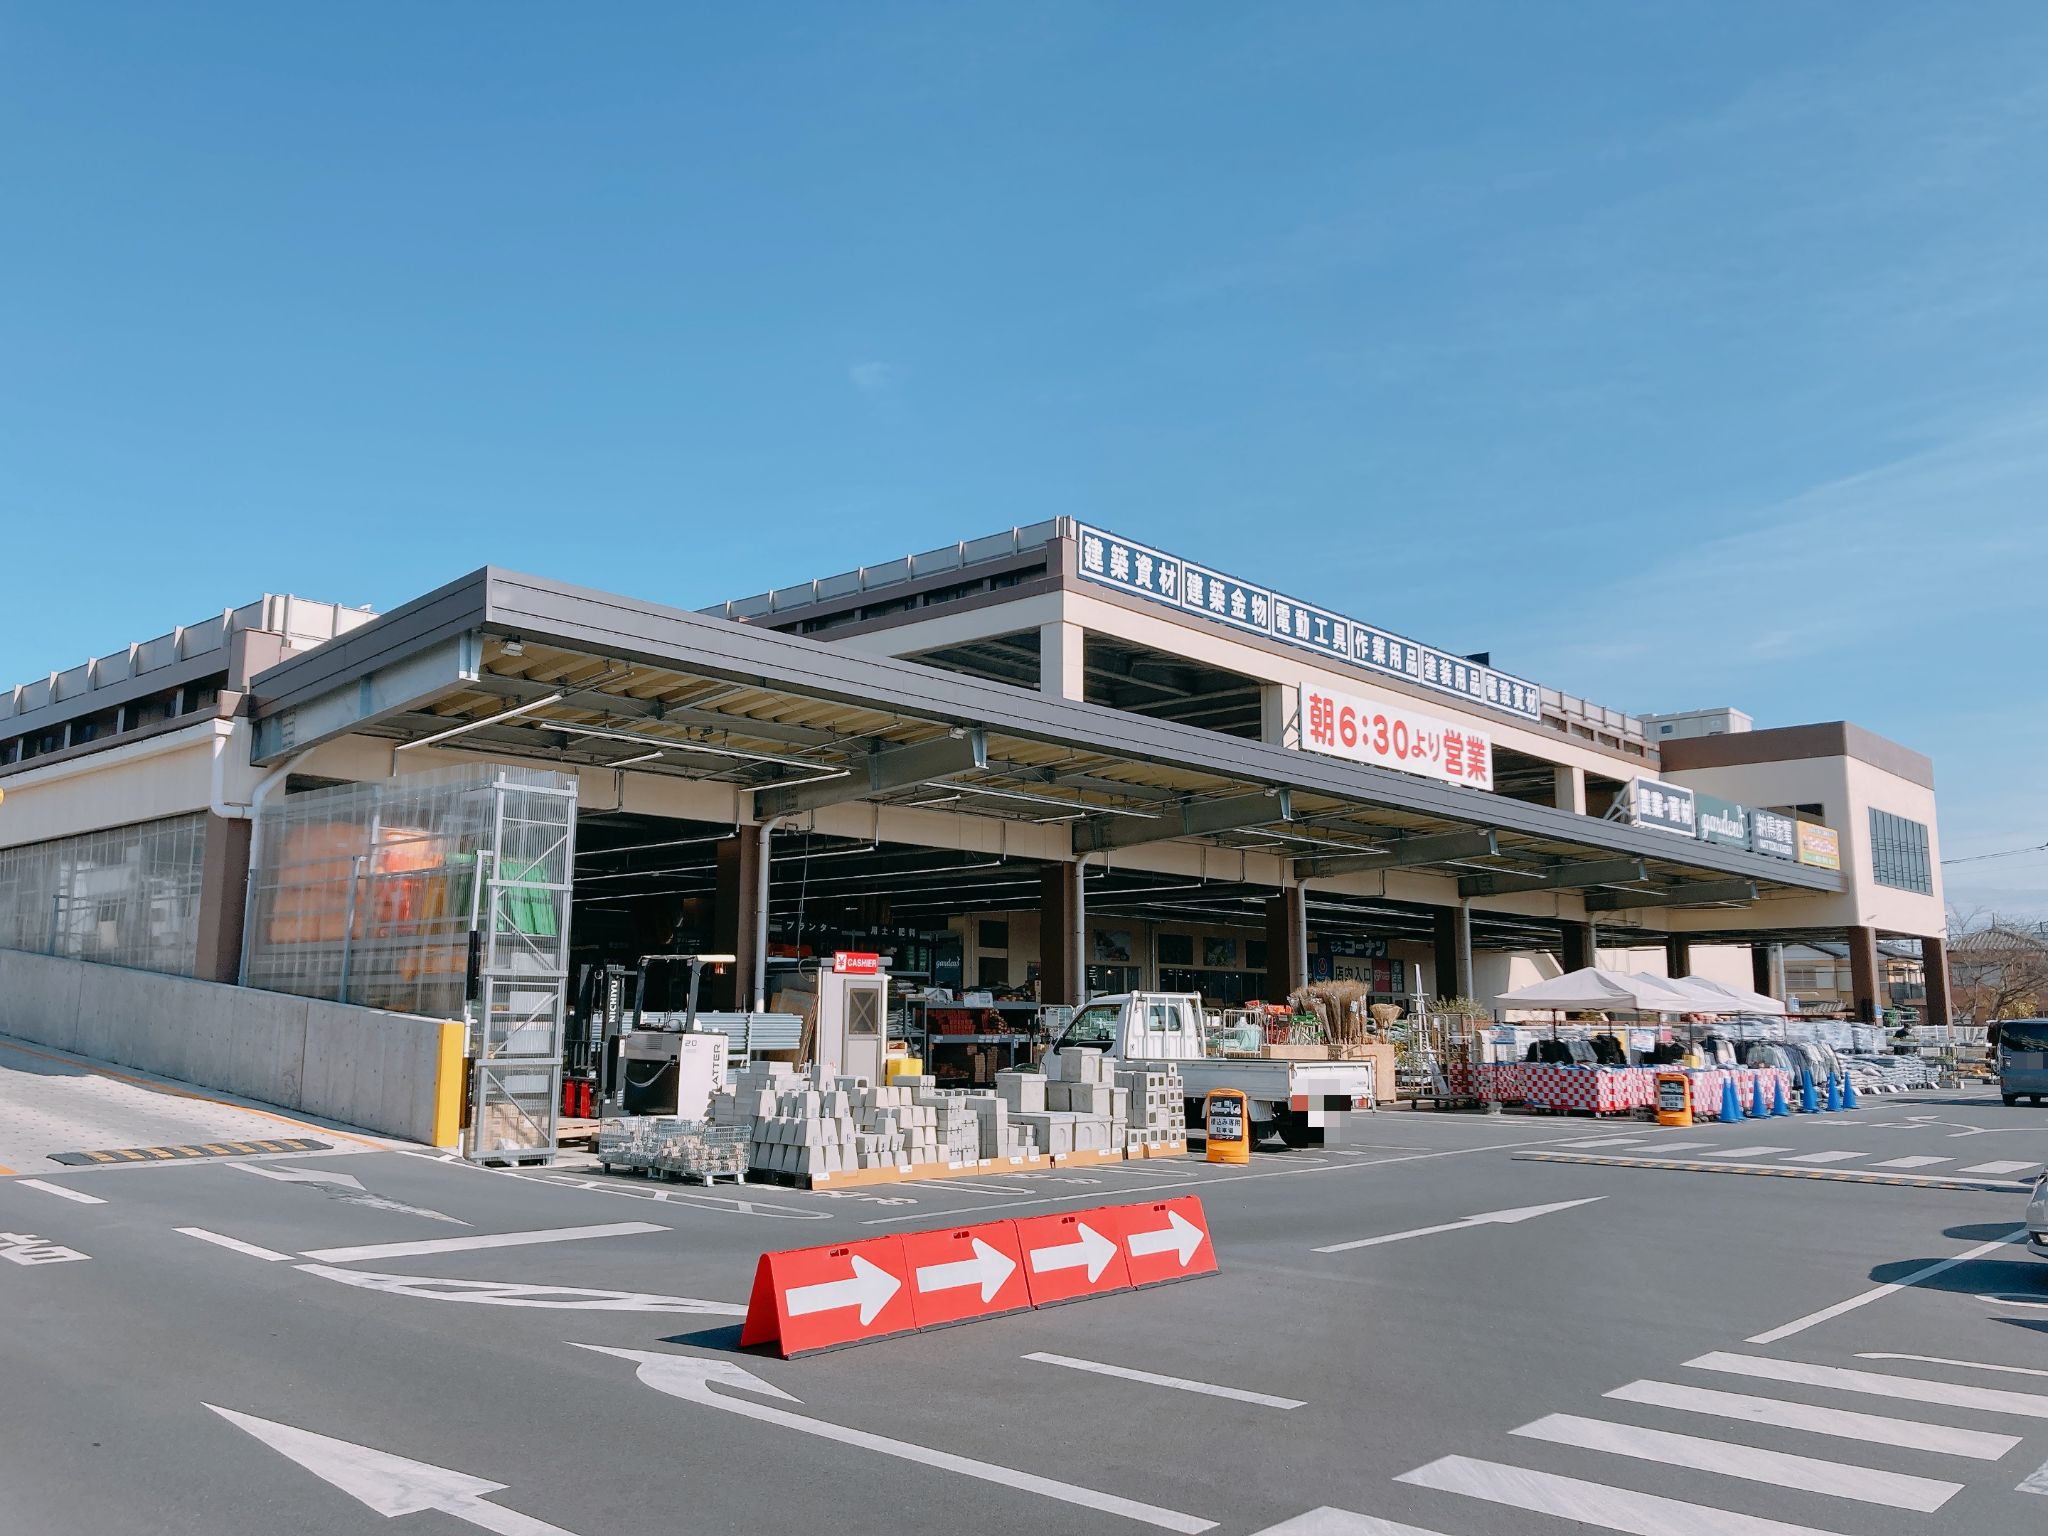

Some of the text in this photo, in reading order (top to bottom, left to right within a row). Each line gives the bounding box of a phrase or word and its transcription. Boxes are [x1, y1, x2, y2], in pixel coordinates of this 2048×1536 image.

[1084, 535, 1177, 597] 建築資材
[1186, 571, 1267, 626] 建築金物
[1275, 601, 1347, 653] 電動工具
[1354, 630, 1418, 676] 作業用品
[1424, 653, 1481, 696] 塗装用品
[1308, 692, 1488, 783] 朝6:30より営業
[847, 958, 877, 968] CASHIER
[1335, 966, 1371, 981] 店内入口
[608, 980, 618, 1023] NICHIYU
[684, 1039, 698, 1047] 20
